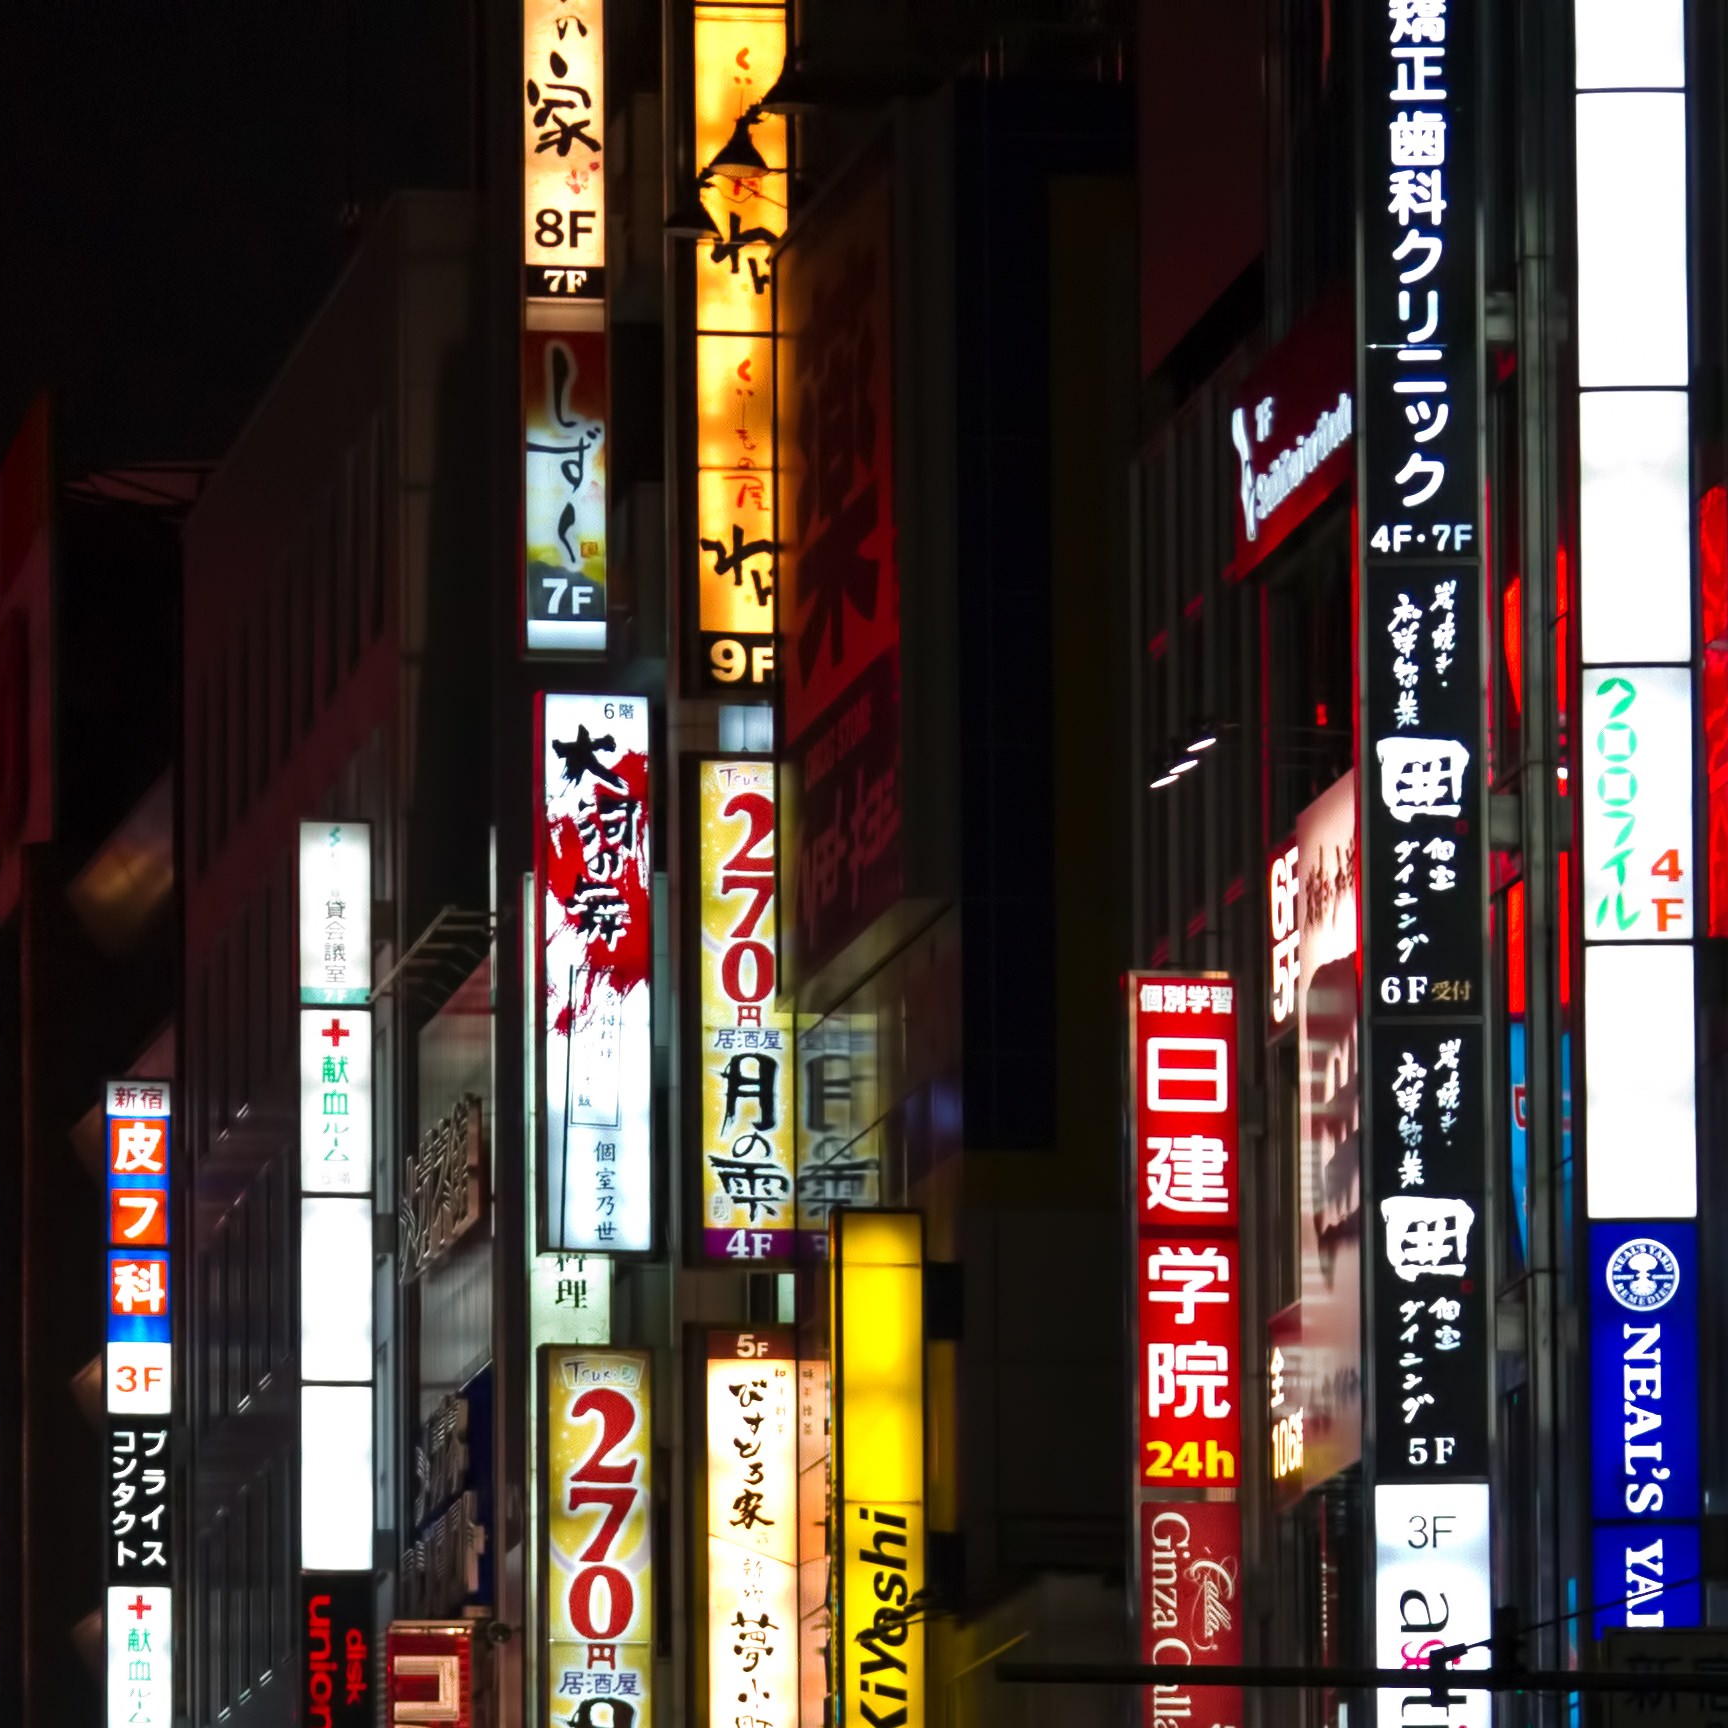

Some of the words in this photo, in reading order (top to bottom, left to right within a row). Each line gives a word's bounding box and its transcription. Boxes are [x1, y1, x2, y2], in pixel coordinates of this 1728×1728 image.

[534, 209, 596, 249] 8F
[543, 270, 587, 293] 7F
[542, 578, 594, 614] 7F
[709, 641, 775, 683] 9F
[603, 703, 635, 721] 6階
[1139, 984, 1233, 1014] 個別学習
[1380, 975, 1429, 1006] 6F
[714, 1029, 784, 1051] 居酒屋
[114, 1085, 164, 1111] 新宿
[322, 1055, 350, 1161] 献血ルーム
[726, 1231, 773, 1259] 4F
[1146, 1037, 1232, 1420] 日建学院
[736, 1336, 769, 1358] 5F
[115, 1365, 163, 1393] 3F
[1623, 1322, 1665, 1514] NEAL'S
[1145, 1441, 1235, 1478] 24h
[1407, 1437, 1456, 1465] 5F
[112, 1431, 137, 1567] コンタクト
[141, 1430, 167, 1566] プライス
[1407, 1515, 1456, 1549] 3F
[1151, 1512, 1193, 1631] Ginza
[345, 1628, 368, 1706] disk
[559, 1670, 641, 1697] 居酒屋
